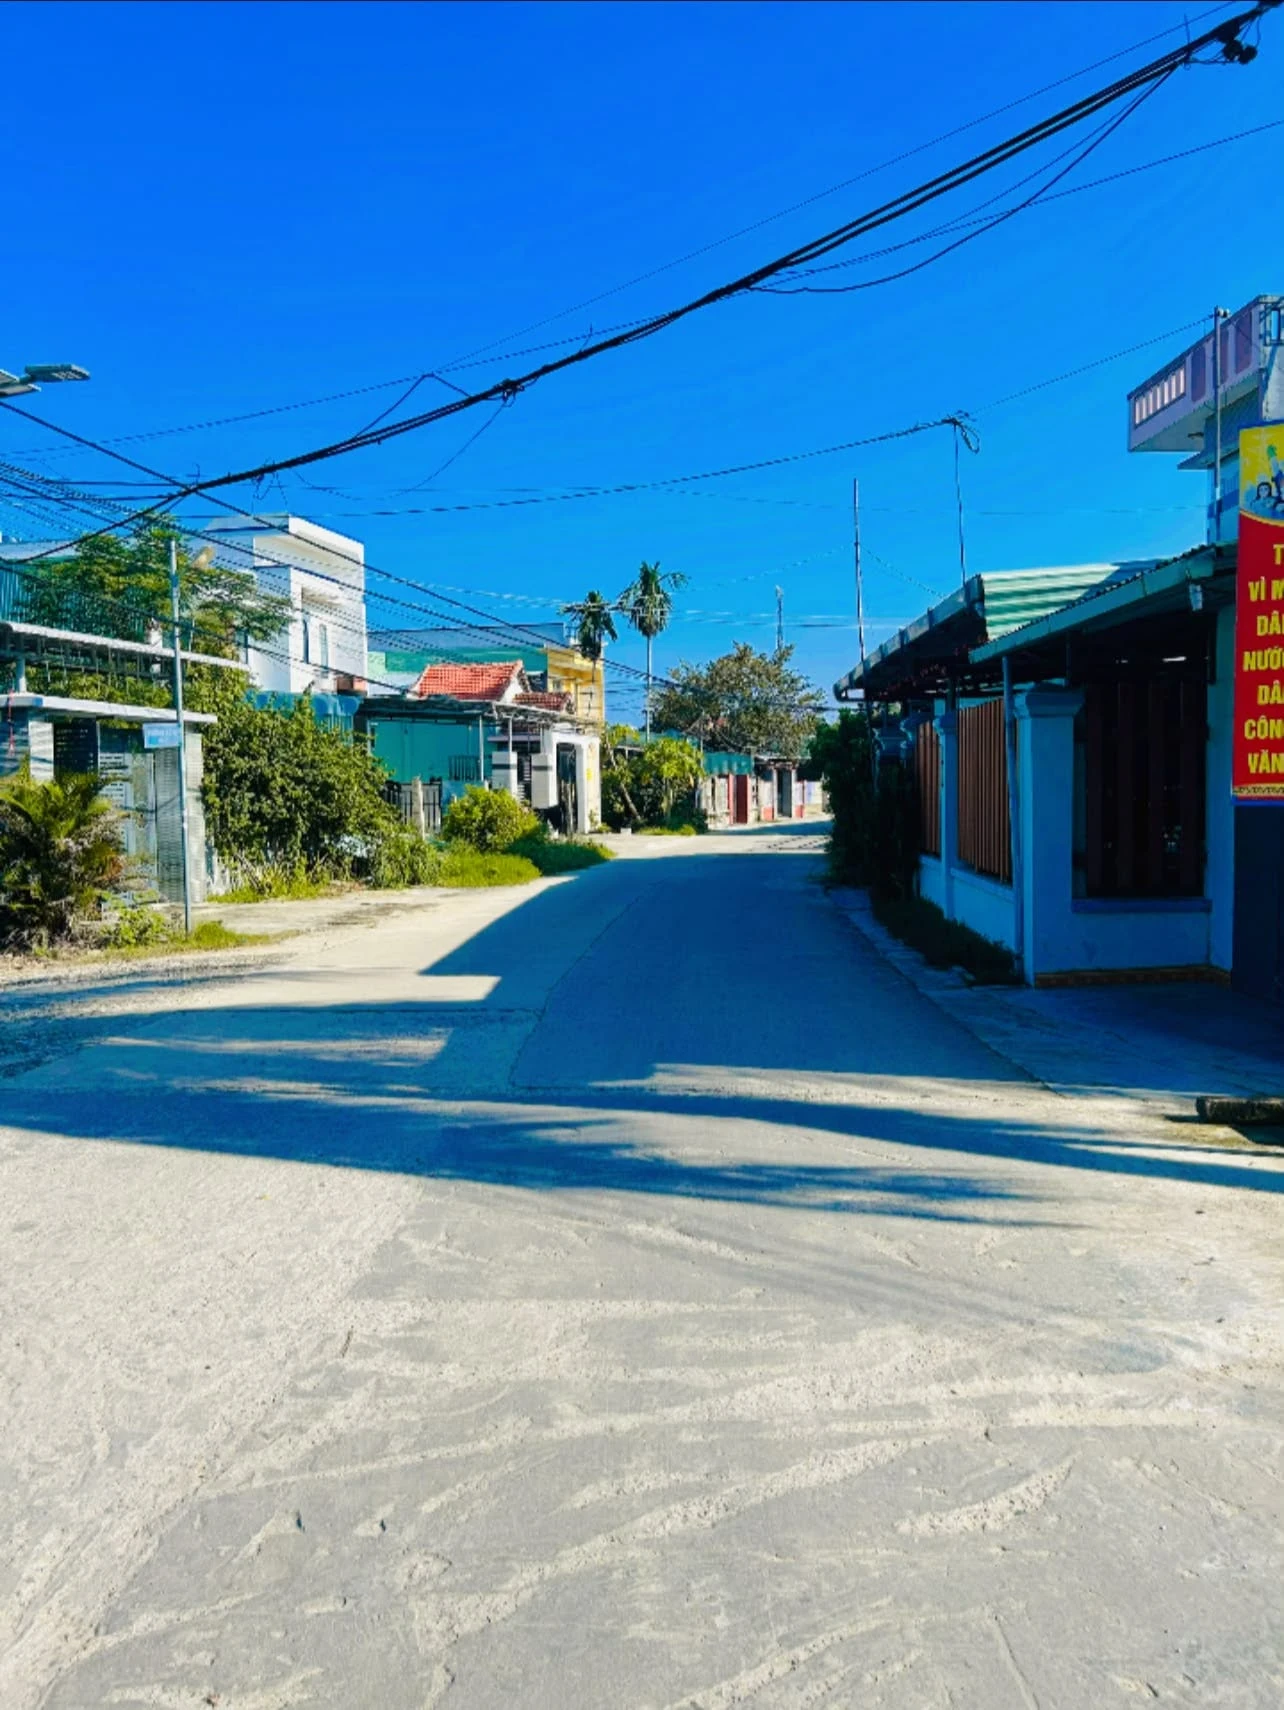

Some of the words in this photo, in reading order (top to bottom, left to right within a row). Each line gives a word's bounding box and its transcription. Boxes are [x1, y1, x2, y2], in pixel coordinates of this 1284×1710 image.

[1248, 576, 1266, 602] VÌ
[1257, 610, 1284, 637] DÂ
[1243, 646, 1284, 672] NƯỚ
[1257, 679, 1284, 705] DÂ
[1244, 715, 1284, 740] CÔN
[1247, 749, 1284, 774] VĂN
